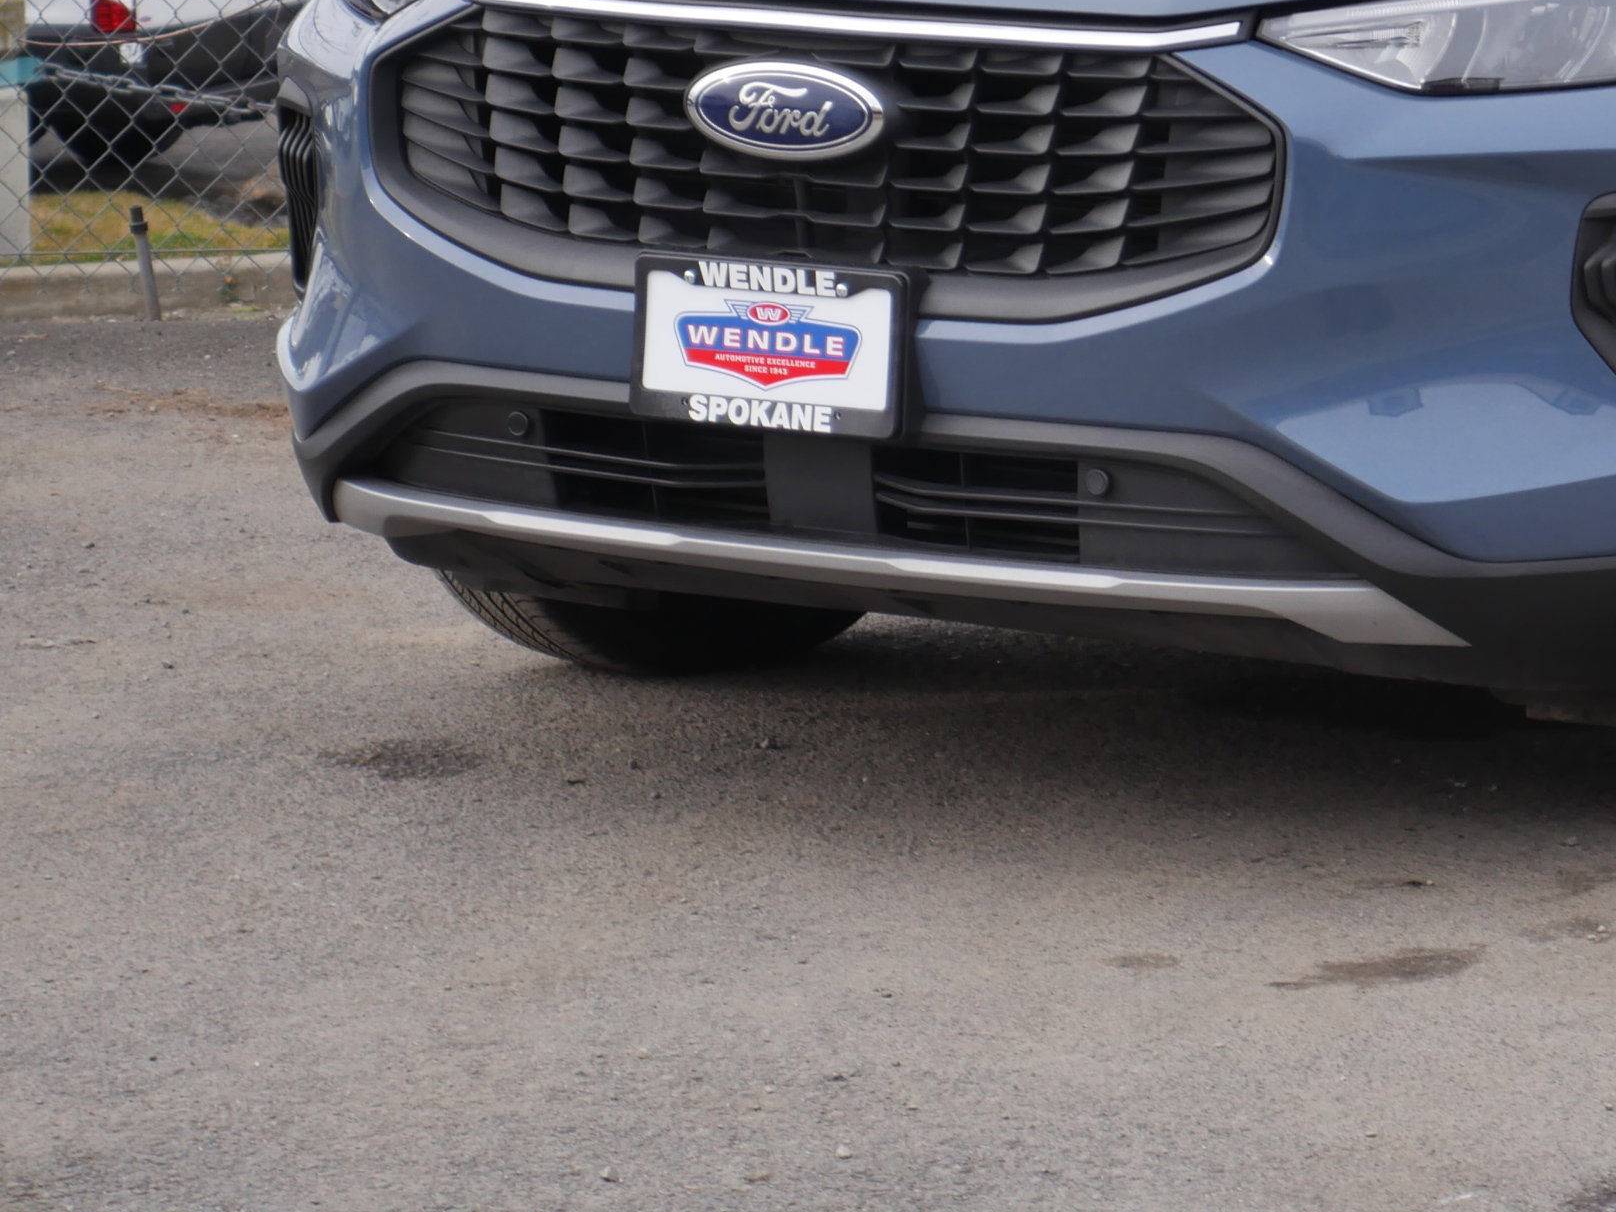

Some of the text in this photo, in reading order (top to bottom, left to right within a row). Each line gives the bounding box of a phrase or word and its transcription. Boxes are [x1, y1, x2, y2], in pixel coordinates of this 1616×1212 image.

[728, 81, 834, 138] Ford
[698, 260, 837, 298] WENDLE
[687, 324, 844, 357] WENDLE
[714, 353, 816, 369] AUTOMOTIVE EXCELLENCE
[744, 365, 768, 374] SINCE
[688, 394, 832, 433] SPOKANE
